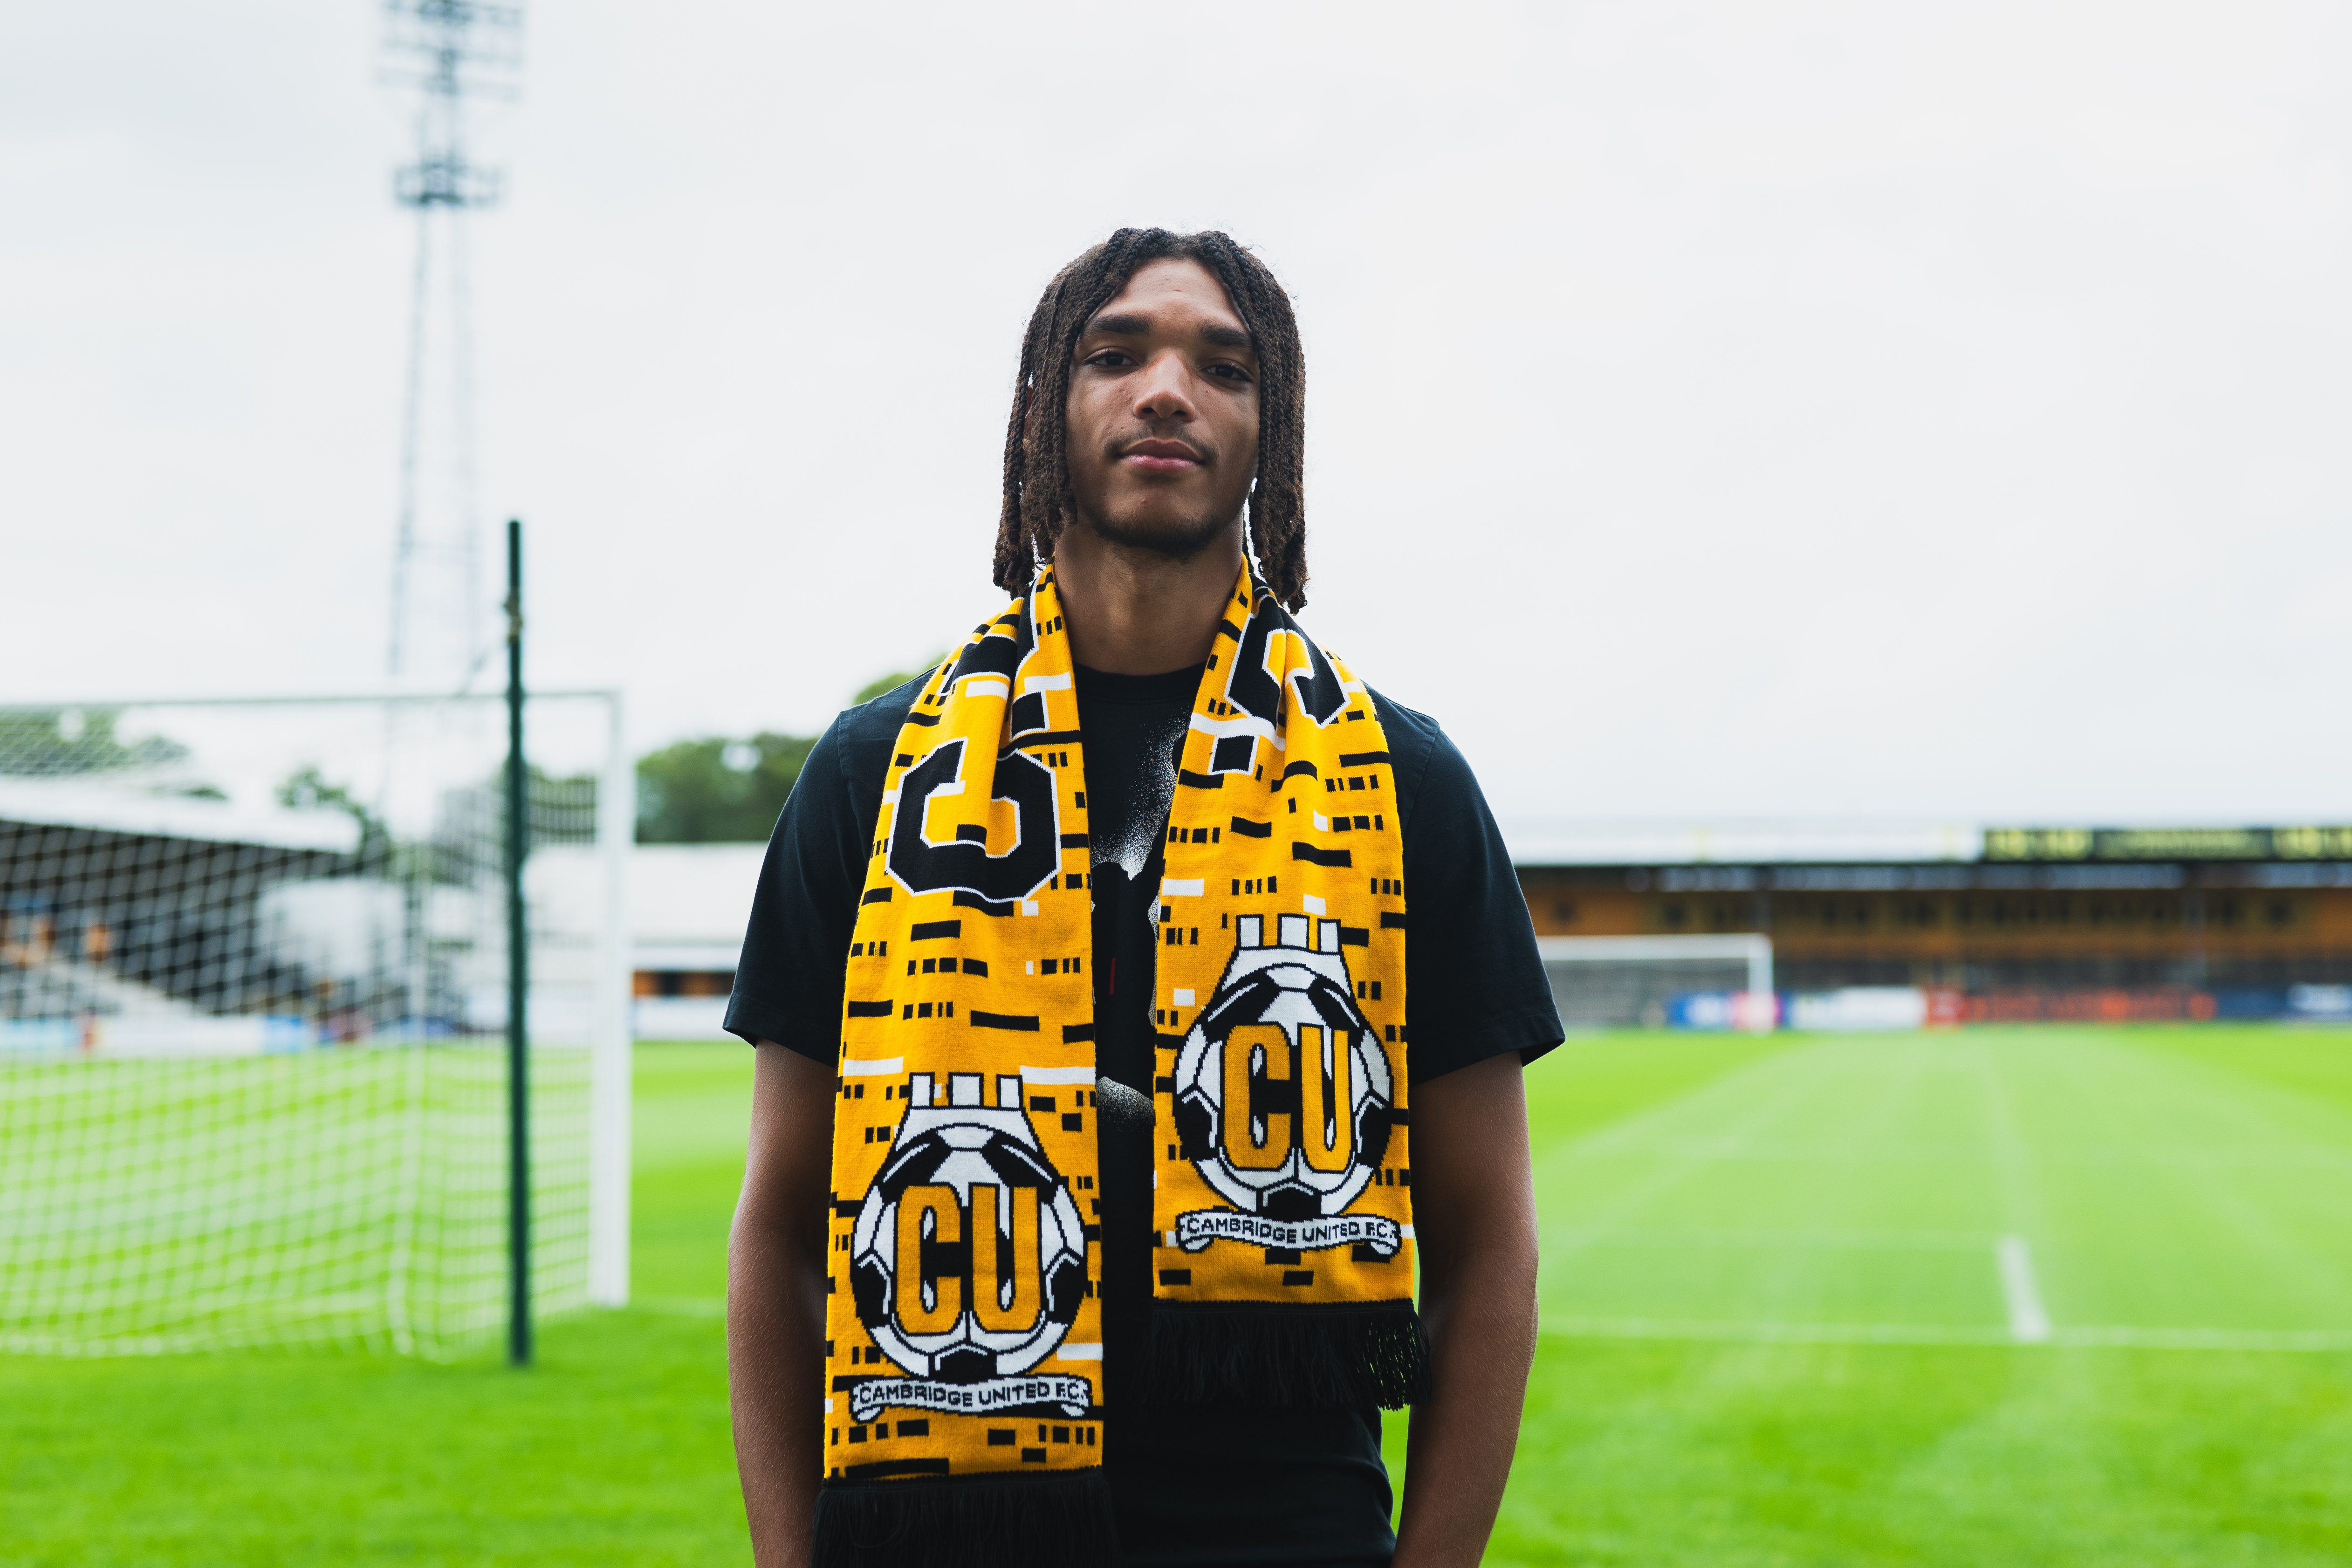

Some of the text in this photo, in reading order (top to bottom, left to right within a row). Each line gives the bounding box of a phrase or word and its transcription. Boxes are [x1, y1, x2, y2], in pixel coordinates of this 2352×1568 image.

[1223, 1024, 1353, 1172] CU
[896, 1183, 1042, 1335] CU
[1187, 1217, 1297, 1244] CAMBRIDGE
[1303, 1221, 1360, 1242] UNITED
[859, 1383, 974, 1407] CAMBRIDGE
[979, 1382, 1050, 1405] UNITED
